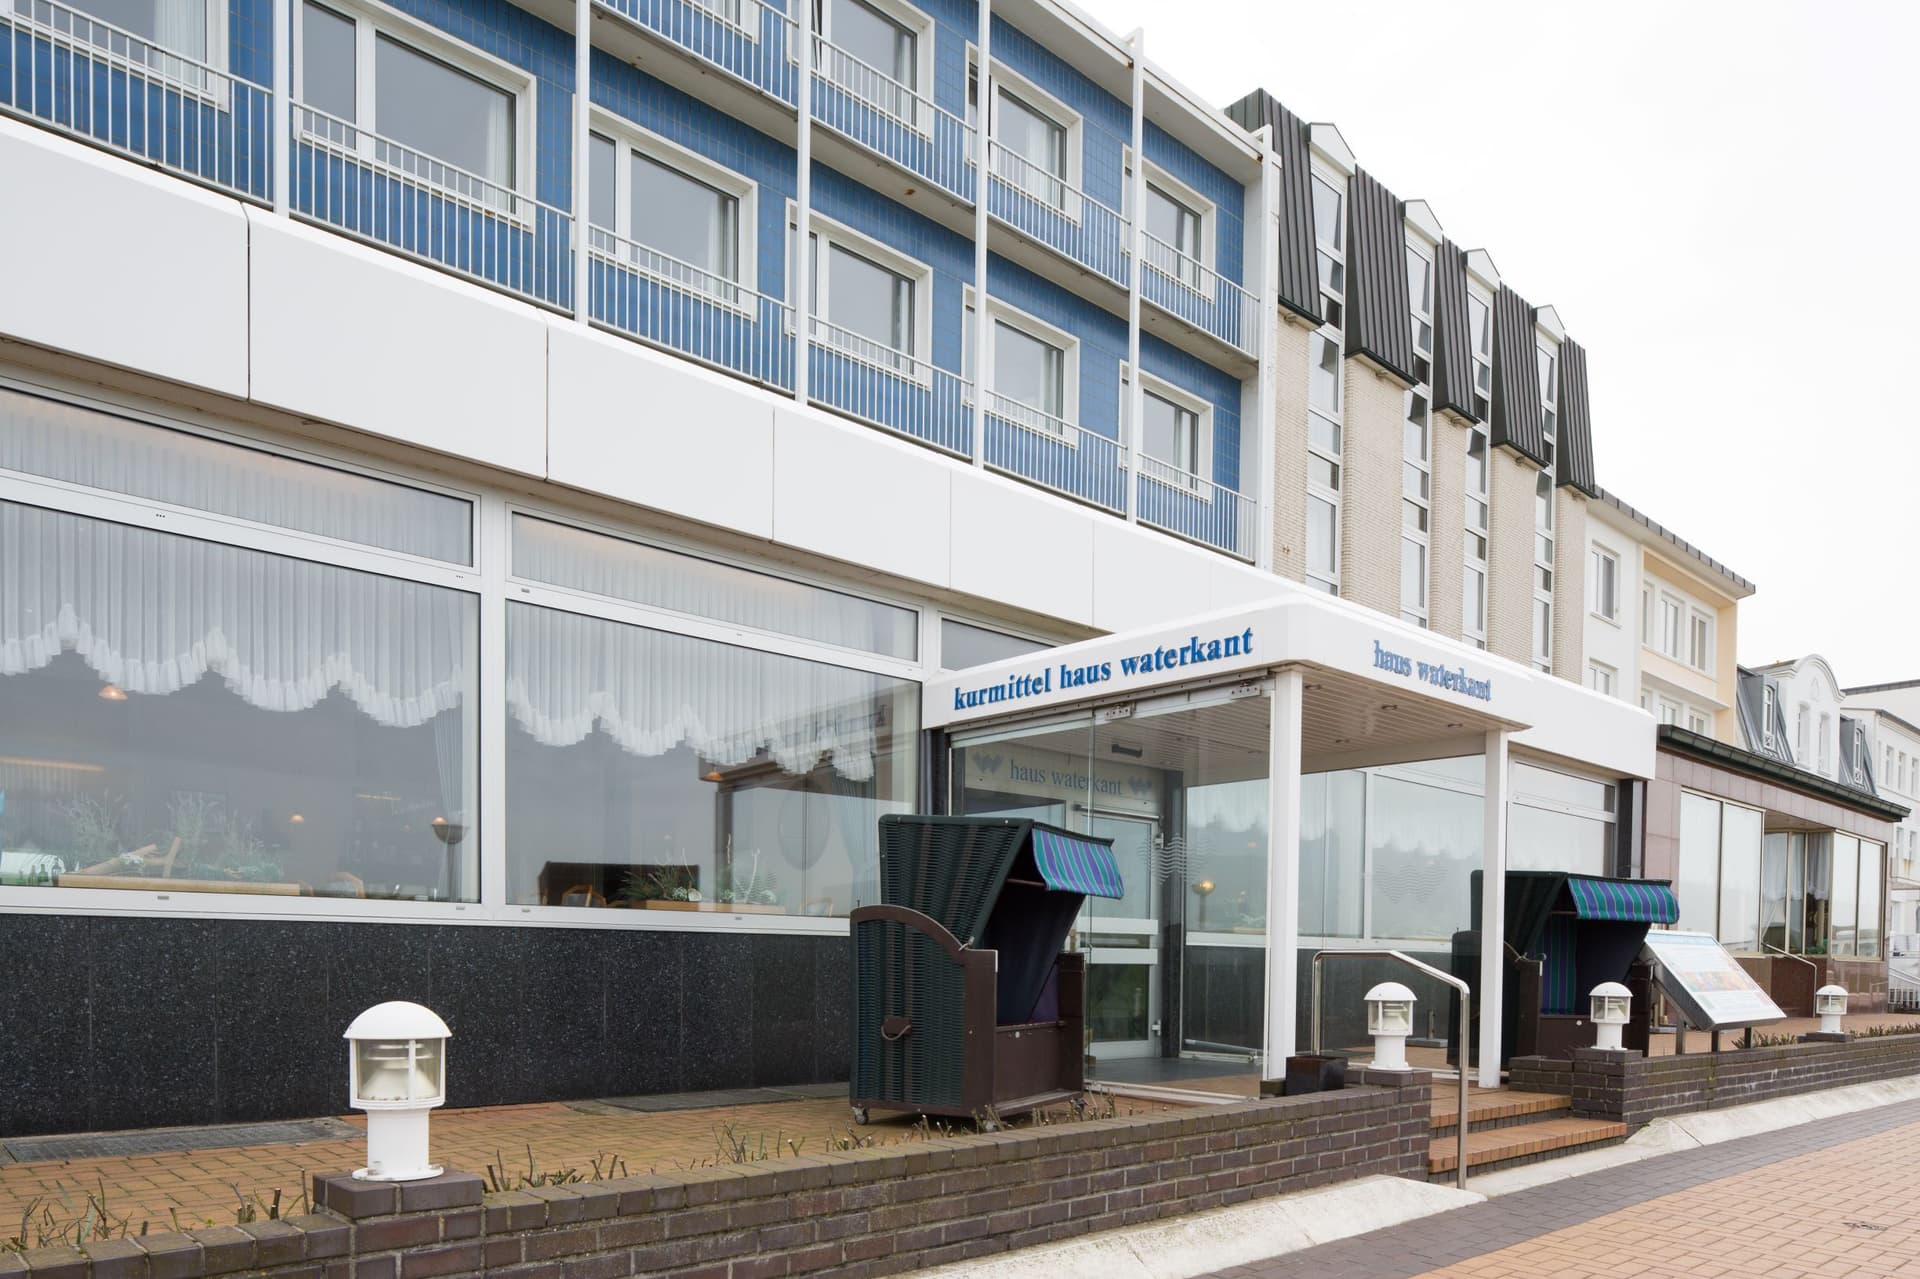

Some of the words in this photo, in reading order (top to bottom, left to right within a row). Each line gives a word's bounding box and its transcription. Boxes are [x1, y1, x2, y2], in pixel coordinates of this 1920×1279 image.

[954, 667, 1052, 711] kurmittel
[1059, 661, 1112, 689] haus
[1120, 627, 1254, 676] waterkant
[1373, 640, 1413, 677] haus
[1416, 660, 1492, 701] waterkant
[1010, 759, 1046, 783] haus
